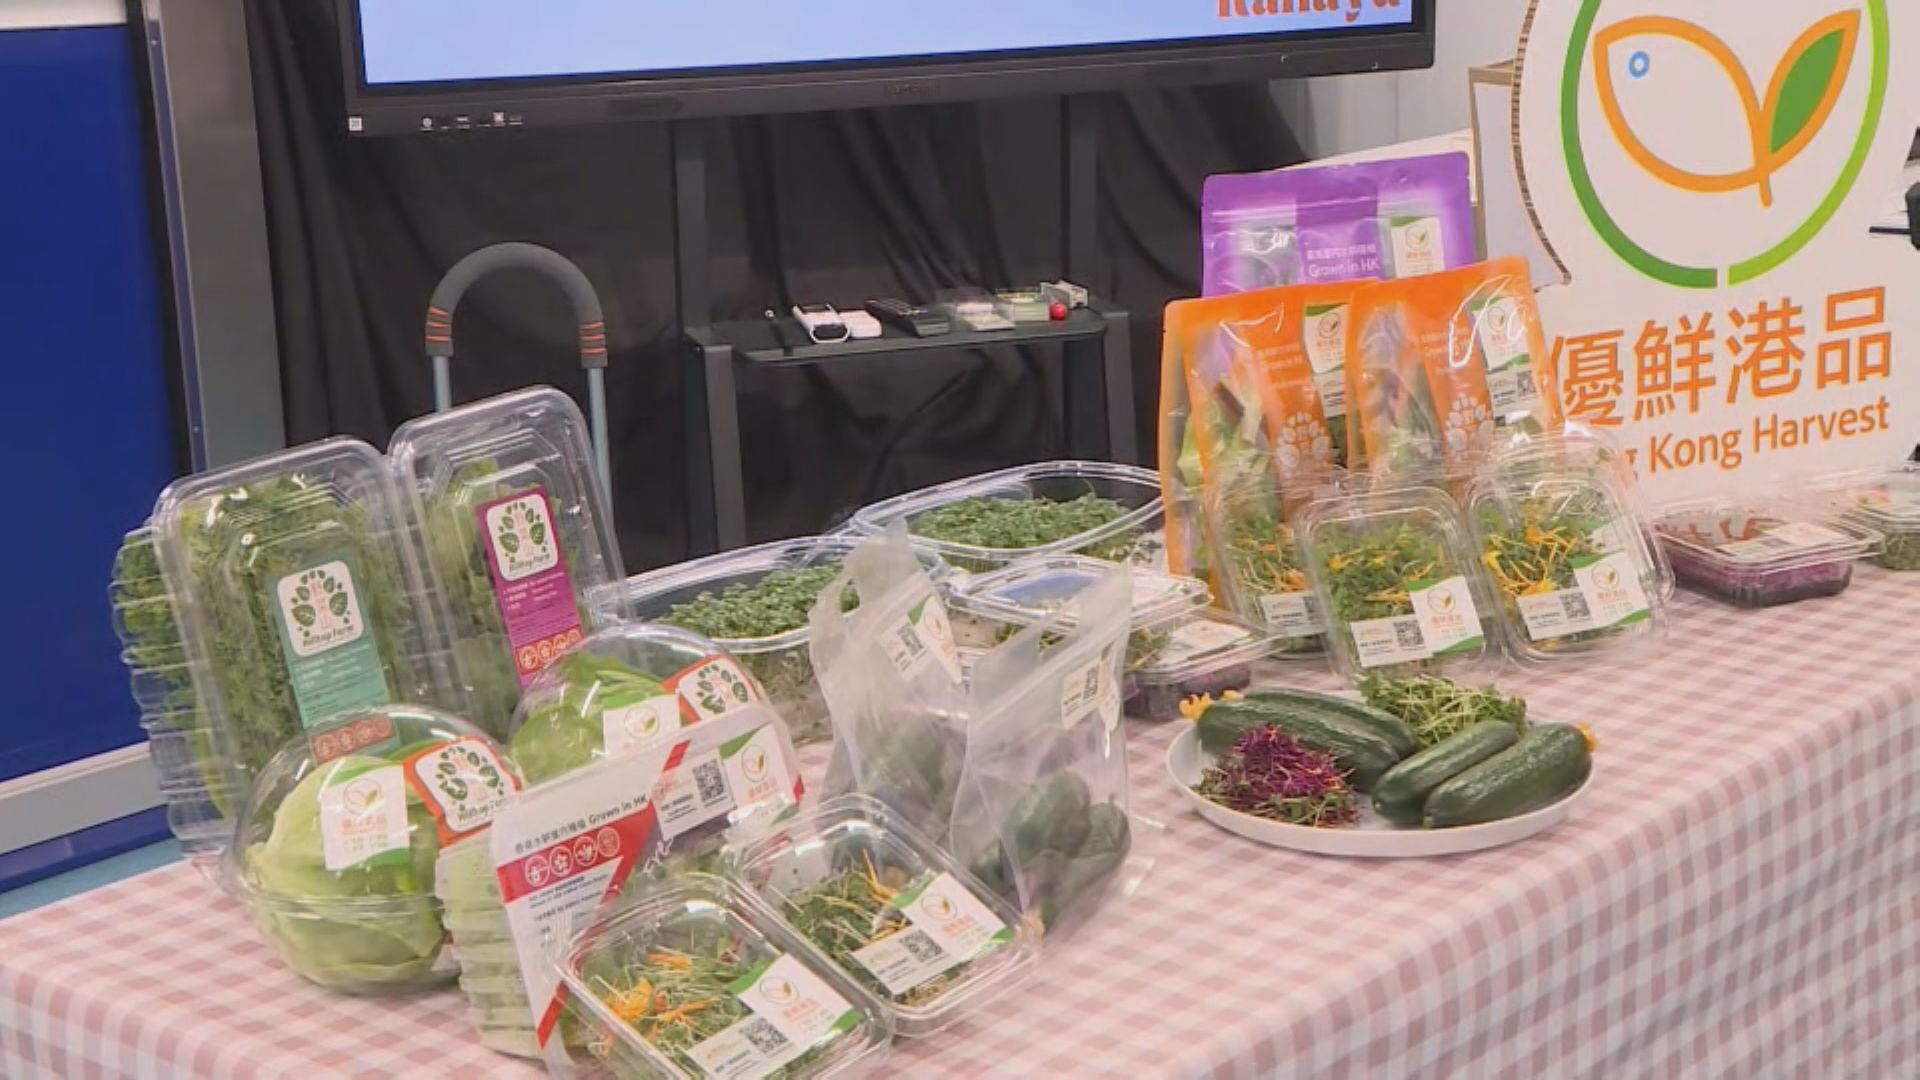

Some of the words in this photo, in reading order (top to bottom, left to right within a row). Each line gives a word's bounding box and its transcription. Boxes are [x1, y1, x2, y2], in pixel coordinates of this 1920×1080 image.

[1550, 286, 1892, 426] 優鮮港品
[1650, 429, 1742, 473] Kong
[1754, 396, 1890, 453] Harvest
